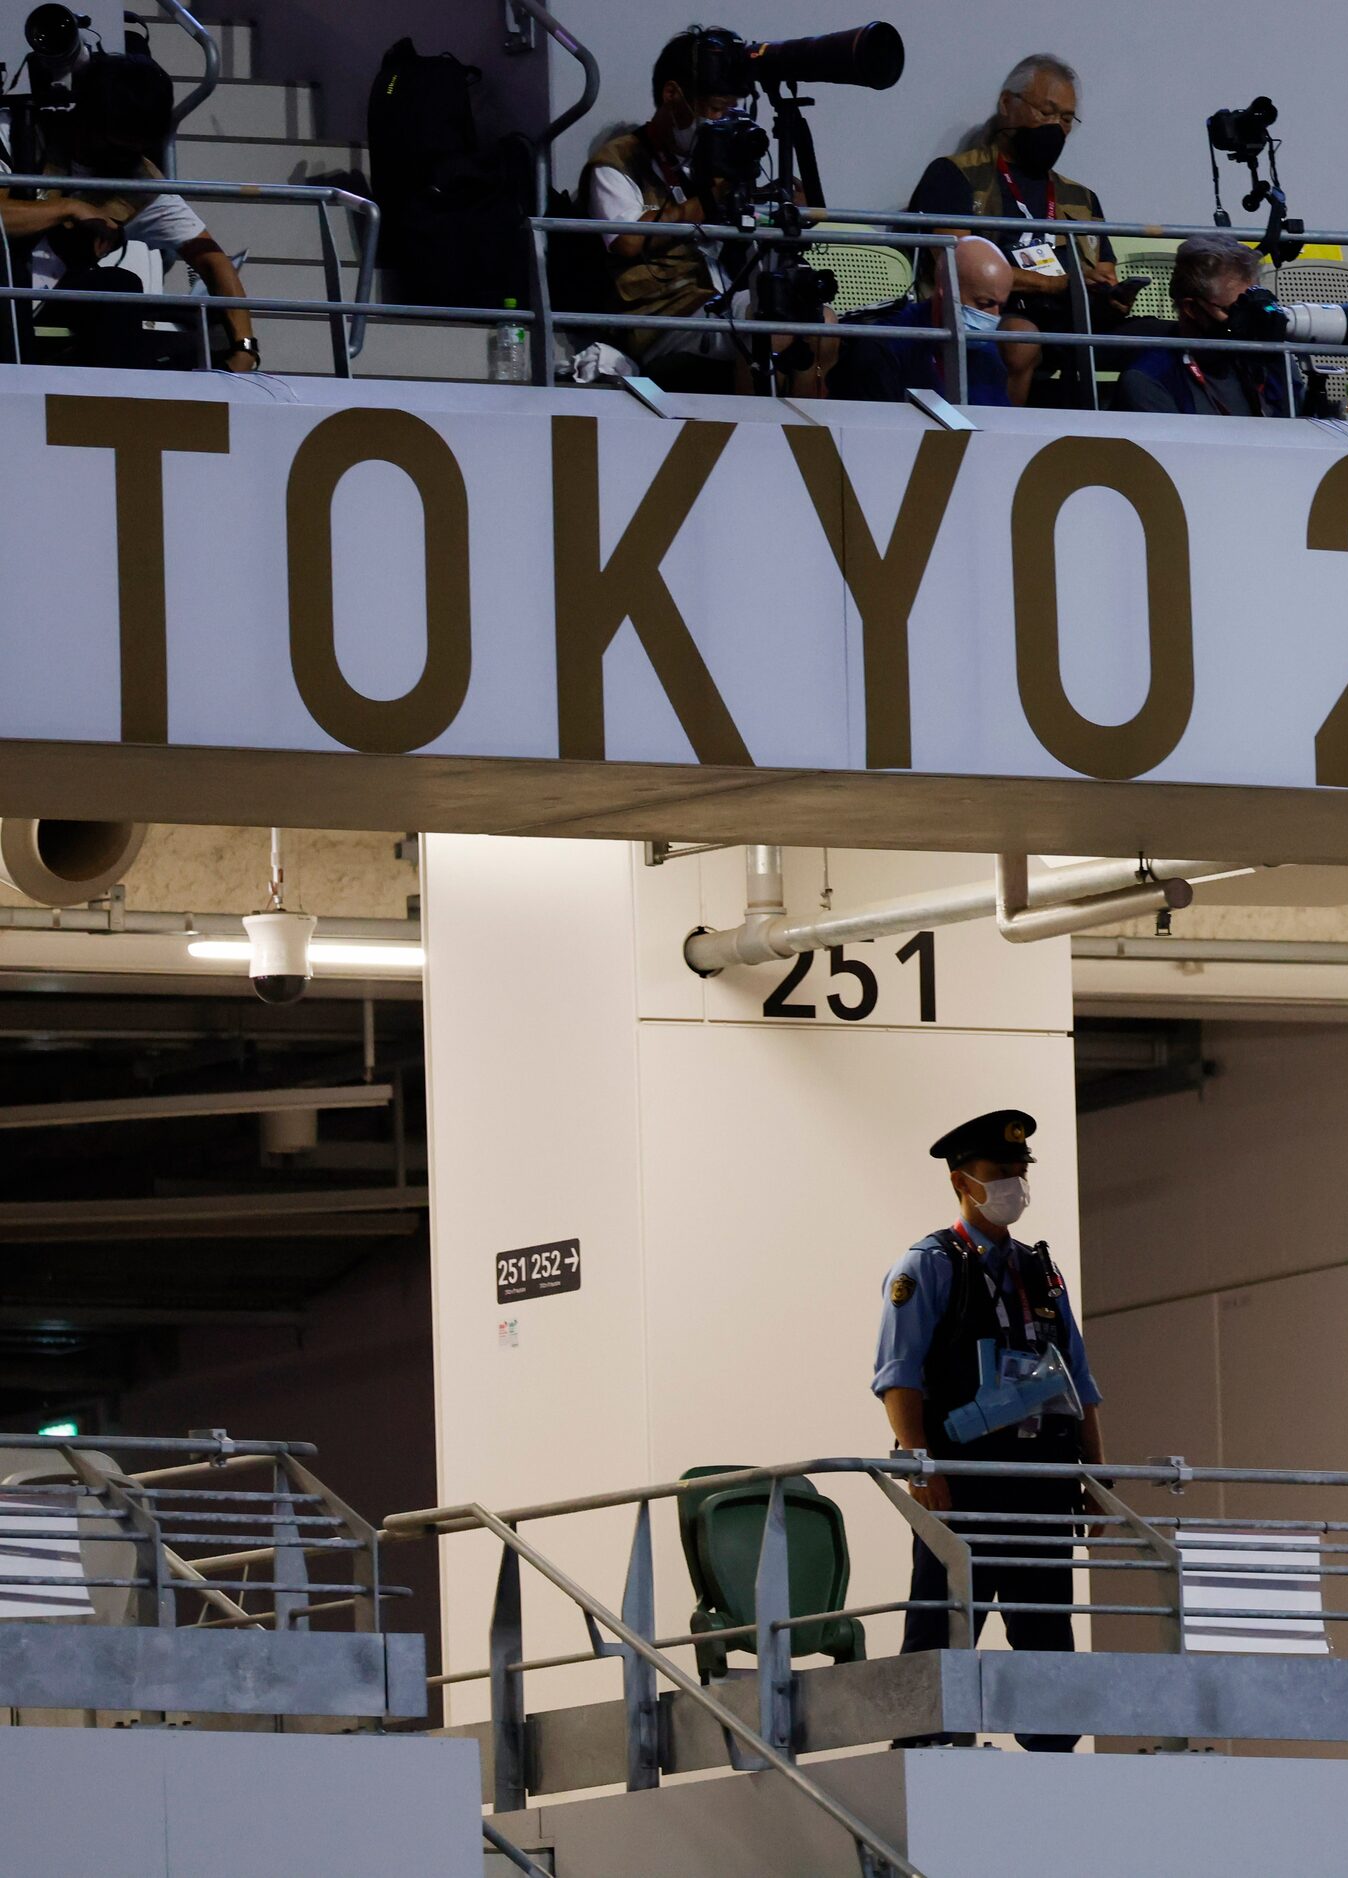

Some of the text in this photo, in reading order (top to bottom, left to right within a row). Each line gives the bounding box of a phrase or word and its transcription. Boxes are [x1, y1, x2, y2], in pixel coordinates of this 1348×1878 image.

[45, 394, 1195, 780] TOKYO
[763, 931, 936, 1022] 251
[498, 1250, 561, 1286] 251 252
